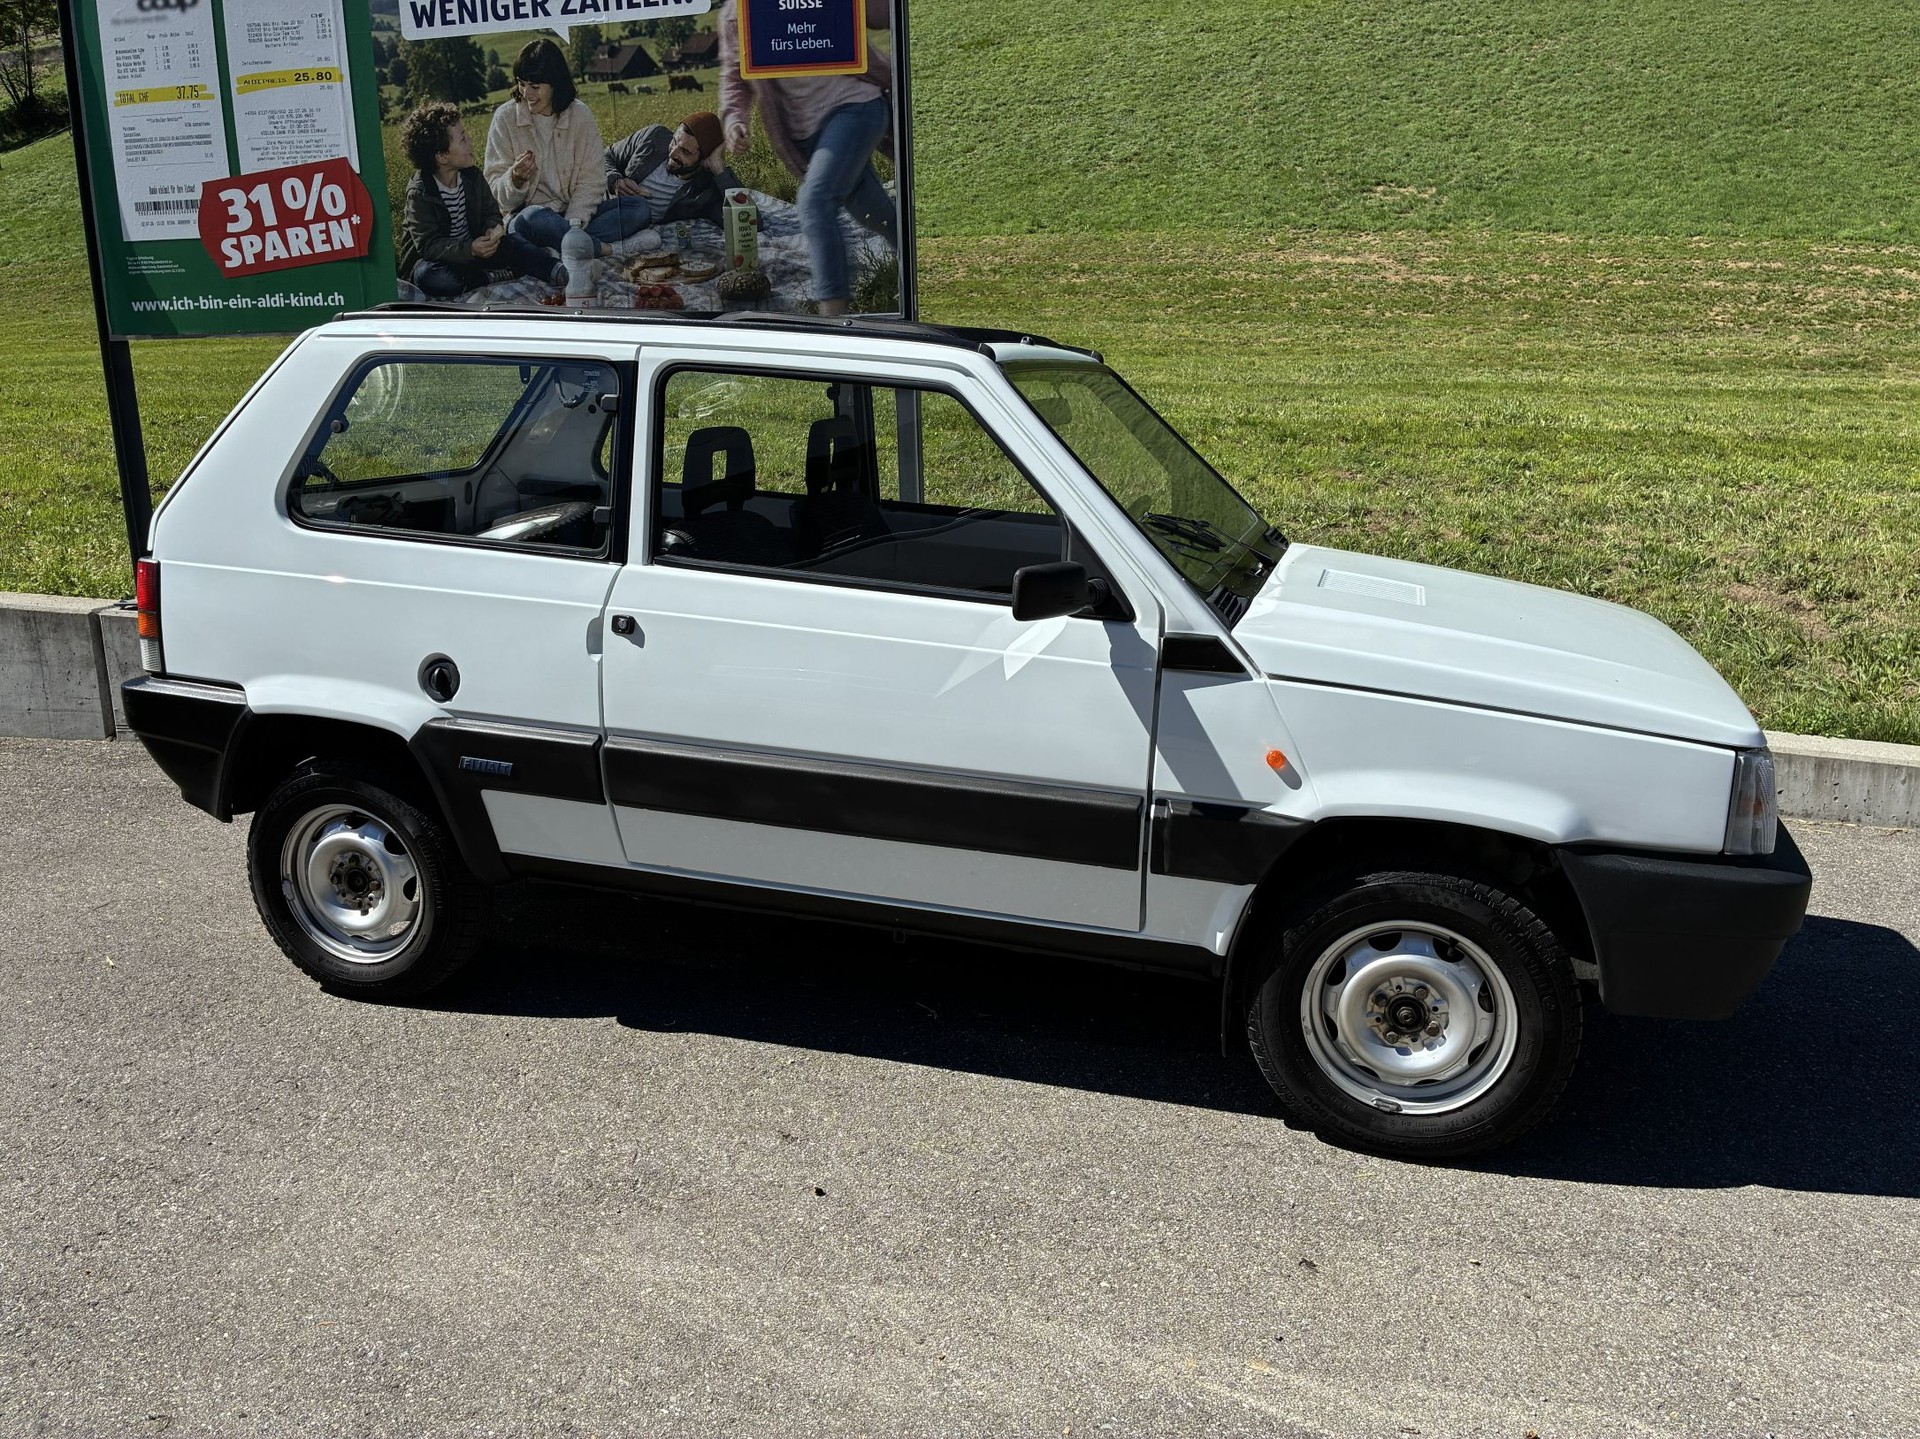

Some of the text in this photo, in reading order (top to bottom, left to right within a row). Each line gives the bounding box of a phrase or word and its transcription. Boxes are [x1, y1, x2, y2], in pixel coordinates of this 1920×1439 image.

[778, 0, 823, 10] SUISSE
[409, 0, 552, 28] WENIGER
[787, 21, 817, 34] Mehr
[770, 37, 834, 51] fürs Leben.
[294, 71, 332, 82] 25.80
[119, 92, 136, 104] TOTAL
[176, 85, 199, 100] 37.75
[131, 292, 345, 312] www.ich-bin-ein-aldi-kind.ch
[460, 756, 512, 776] FIAT
